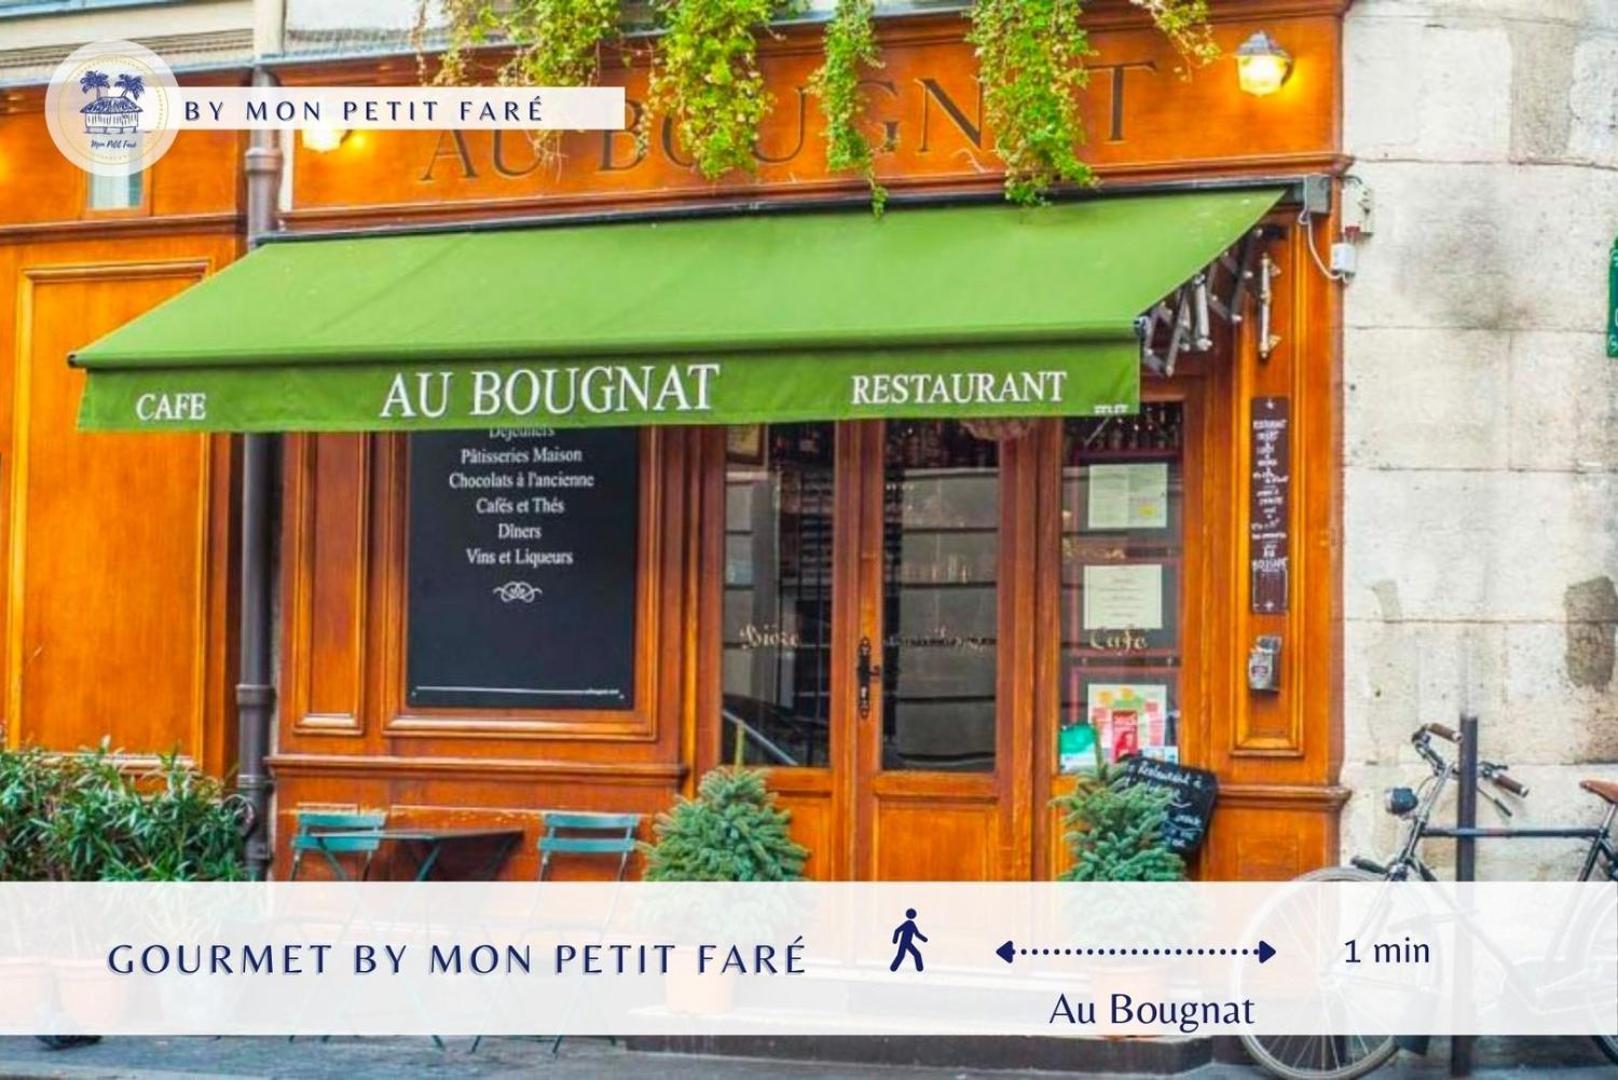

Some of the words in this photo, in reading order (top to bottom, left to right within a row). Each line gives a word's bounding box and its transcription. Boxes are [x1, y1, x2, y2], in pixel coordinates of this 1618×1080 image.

[379, 372, 453, 418] AU
[469, 363, 720, 416] BOUGNAT
[851, 371, 1067, 405] RESTAURANT
[135, 393, 207, 421] CAFE
[533, 446, 583, 462] Maison
[449, 472, 513, 489] Chocolats
[528, 471, 595, 488] l'ancienne
[476, 497, 513, 514] Cafés
[516, 500, 530, 514] et
[534, 497, 565, 514] Thés
[466, 548, 496, 565] Vins
[499, 550, 512, 564] et
[515, 548, 574, 568] Liqueurs
